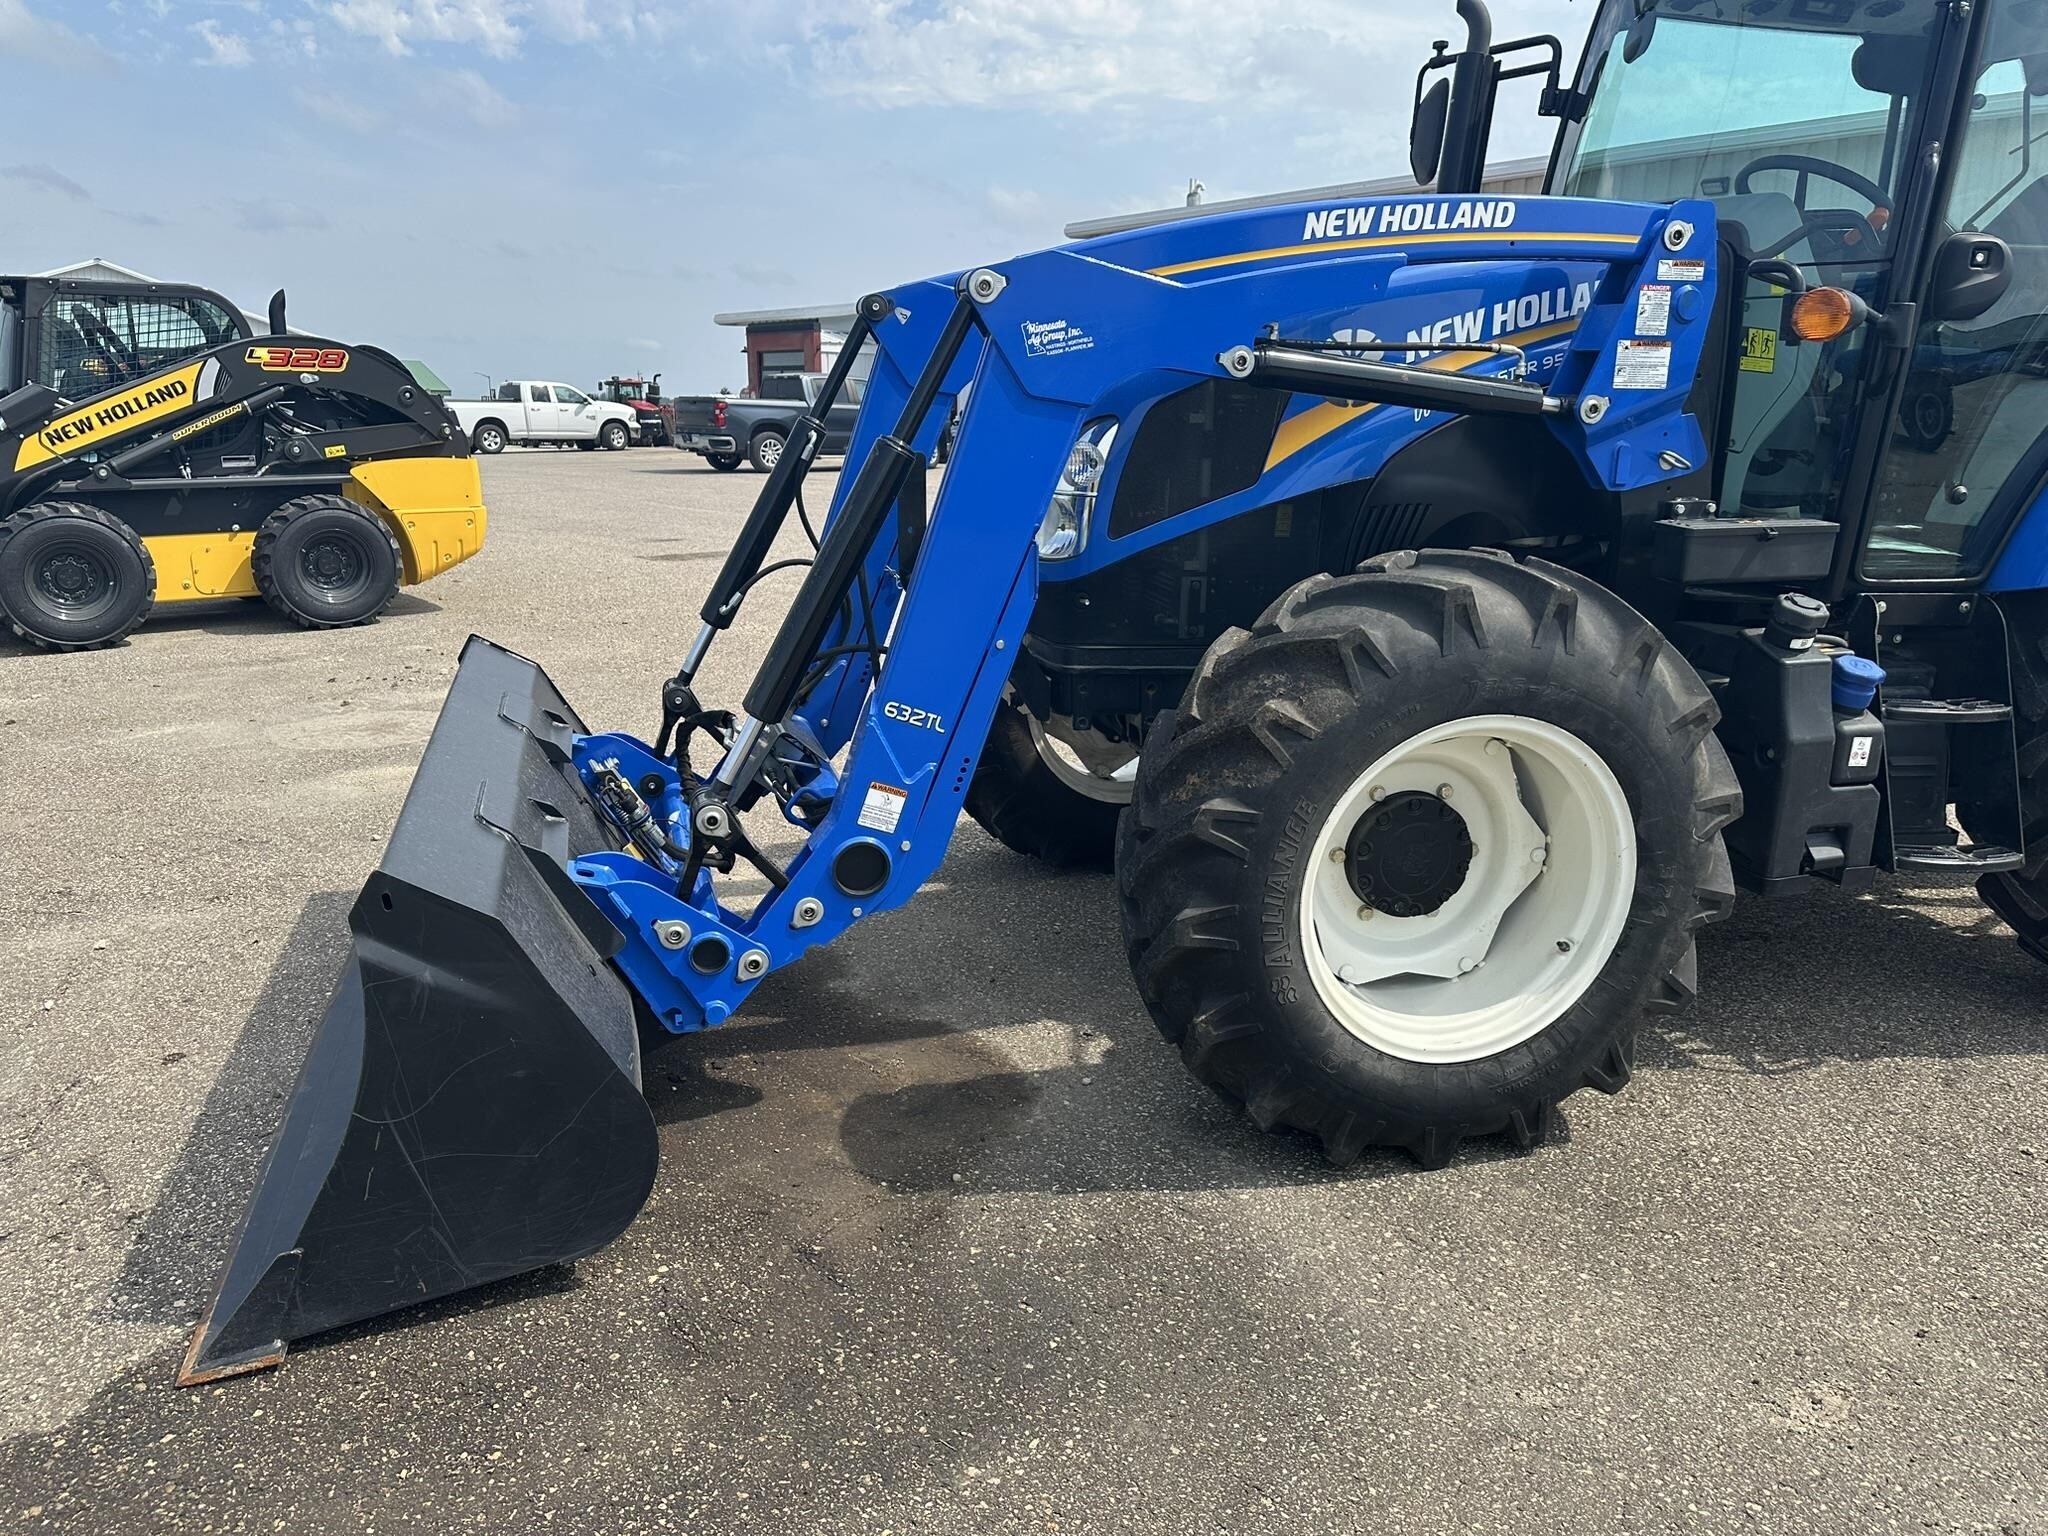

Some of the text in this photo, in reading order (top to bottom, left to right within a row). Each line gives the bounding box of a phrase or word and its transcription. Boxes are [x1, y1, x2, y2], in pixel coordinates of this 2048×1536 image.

[1302, 201, 1516, 240] NEW HOLLAND
[1027, 320, 1067, 334] Minnesota
[1028, 328, 1083, 346] Ag Group, Inc.
[1406, 308, 1486, 364] NEW
[246, 347, 349, 372] L328
[44, 380, 187, 446] NEW HOLLAND
[172, 418, 210, 440] SUPER
[884, 701, 945, 733] 632TL
[877, 784, 907, 797] WARNING
[1262, 796, 1318, 967] ALLIANCE
